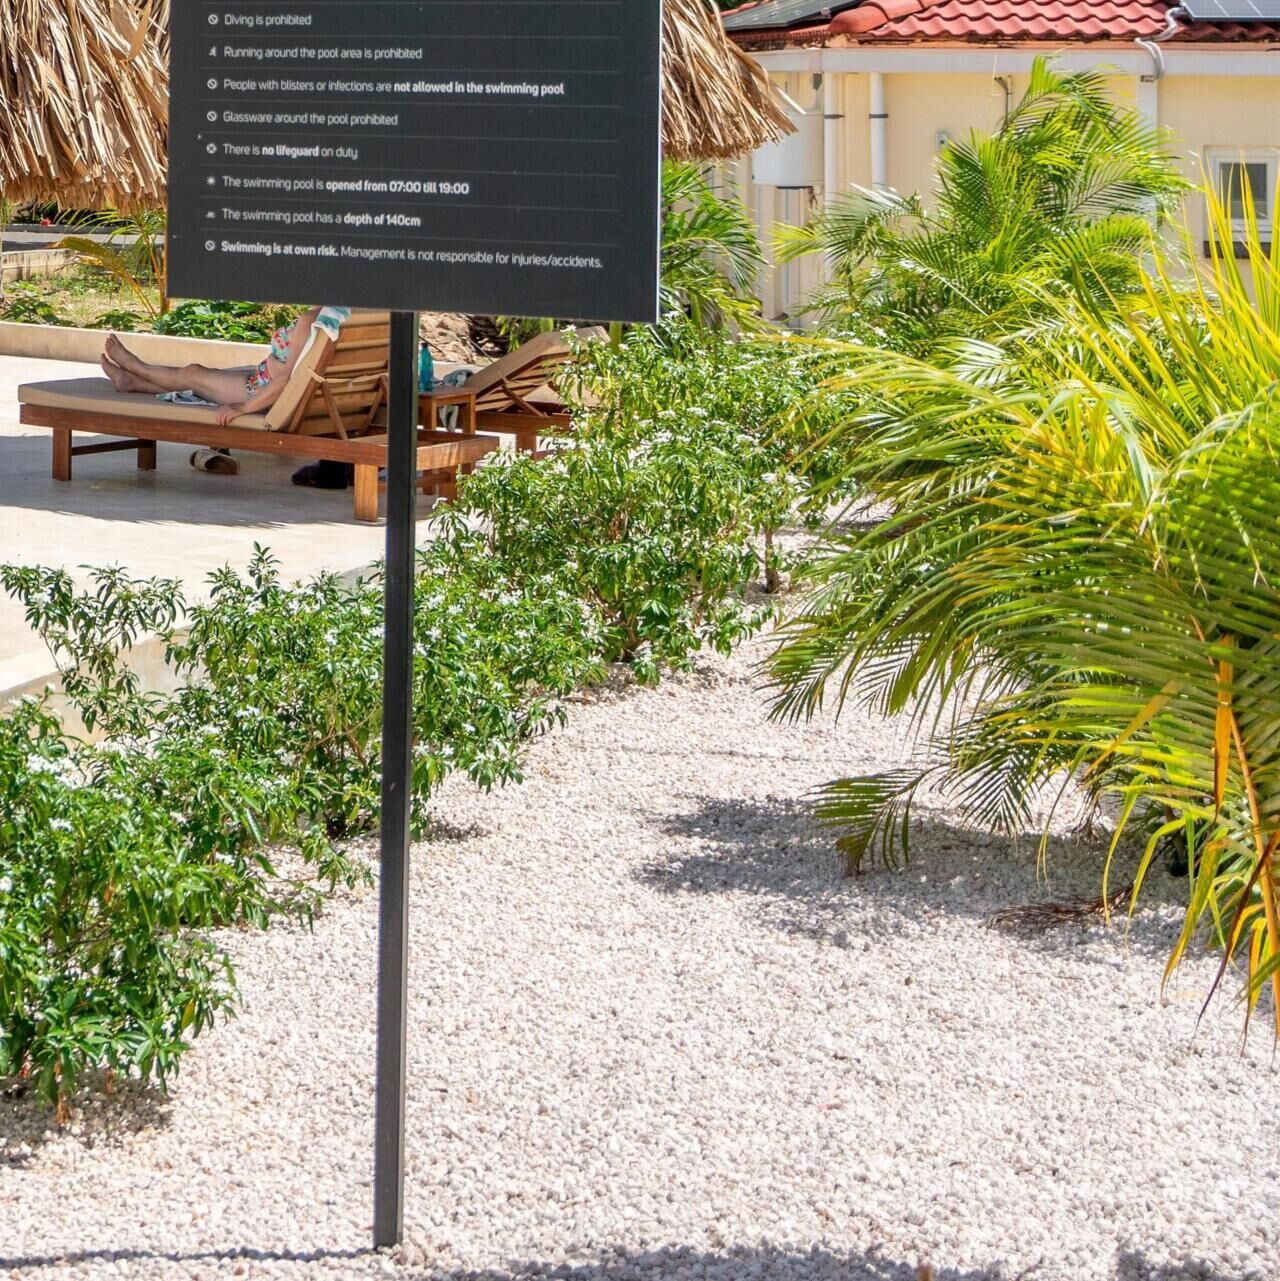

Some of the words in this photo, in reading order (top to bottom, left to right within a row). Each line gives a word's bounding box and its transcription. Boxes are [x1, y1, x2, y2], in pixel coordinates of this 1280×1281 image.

[225, 14, 254, 27] Diving
[256, 15, 264, 25] is
[265, 14, 312, 27] prohibited
[224, 46, 263, 60] Running
[265, 47, 299, 58] around
[300, 47, 316, 58] the
[318, 48, 339, 60] pool
[340, 49, 363, 59] area
[364, 48, 373, 59] is
[374, 48, 423, 61] prohibited
[224, 78, 257, 92] People
[258, 79, 279, 90] with
[281, 80, 315, 91] blisters
[316, 82, 327, 91] or
[328, 80, 374, 92] infections
[376, 82, 392, 92] are
[394, 81, 411, 92] not
[412, 81, 454, 93] allowed
[455, 81, 465, 93] in
[466, 81, 484, 93] the
[485, 81, 539, 97] swimming
[541, 82, 565, 97] pool
[223, 111, 273, 123] Glassware
[274, 113, 308, 124] around
[310, 113, 326, 124] the
[327, 113, 349, 126] pool
[350, 114, 398, 126] prohibited
[222, 143, 251, 155] There
[252, 144, 261, 155] is
[262, 146, 275, 156] no
[276, 144, 320, 159] lifeguard
[321, 148, 334, 157] on
[336, 146, 358, 160] duty
[222, 175, 242, 187] The
[243, 177, 292, 191] swimming
[293, 178, 314, 191] pool
[316, 179, 325, 190] is
[326, 179, 363, 193] opened
[364, 179, 388, 192] from
[389, 180, 422, 193] 07:00
[423, 181, 437, 194] till
[438, 182, 470, 195] 19:00
[221, 208, 241, 220] The
[242, 209, 291, 224] swimming
[293, 211, 314, 224] pool
[315, 211, 333, 223] has
[335, 214, 342, 224] a
[344, 212, 373, 227] depth
[374, 213, 384, 226] of
[385, 214, 421, 227] 140cm
[221, 240, 272, 256] Swimming
[273, 242, 282, 254] is
[283, 244, 293, 255] at
[294, 245, 316, 256] own
[317, 244, 339, 256] risk.
[341, 245, 405, 260] Management
[407, 249, 416, 260] is
[418, 251, 434, 261] not
[436, 251, 494, 264] responsible
[496, 252, 509, 264] for
[512, 253, 603, 268] injuries/accidents.
